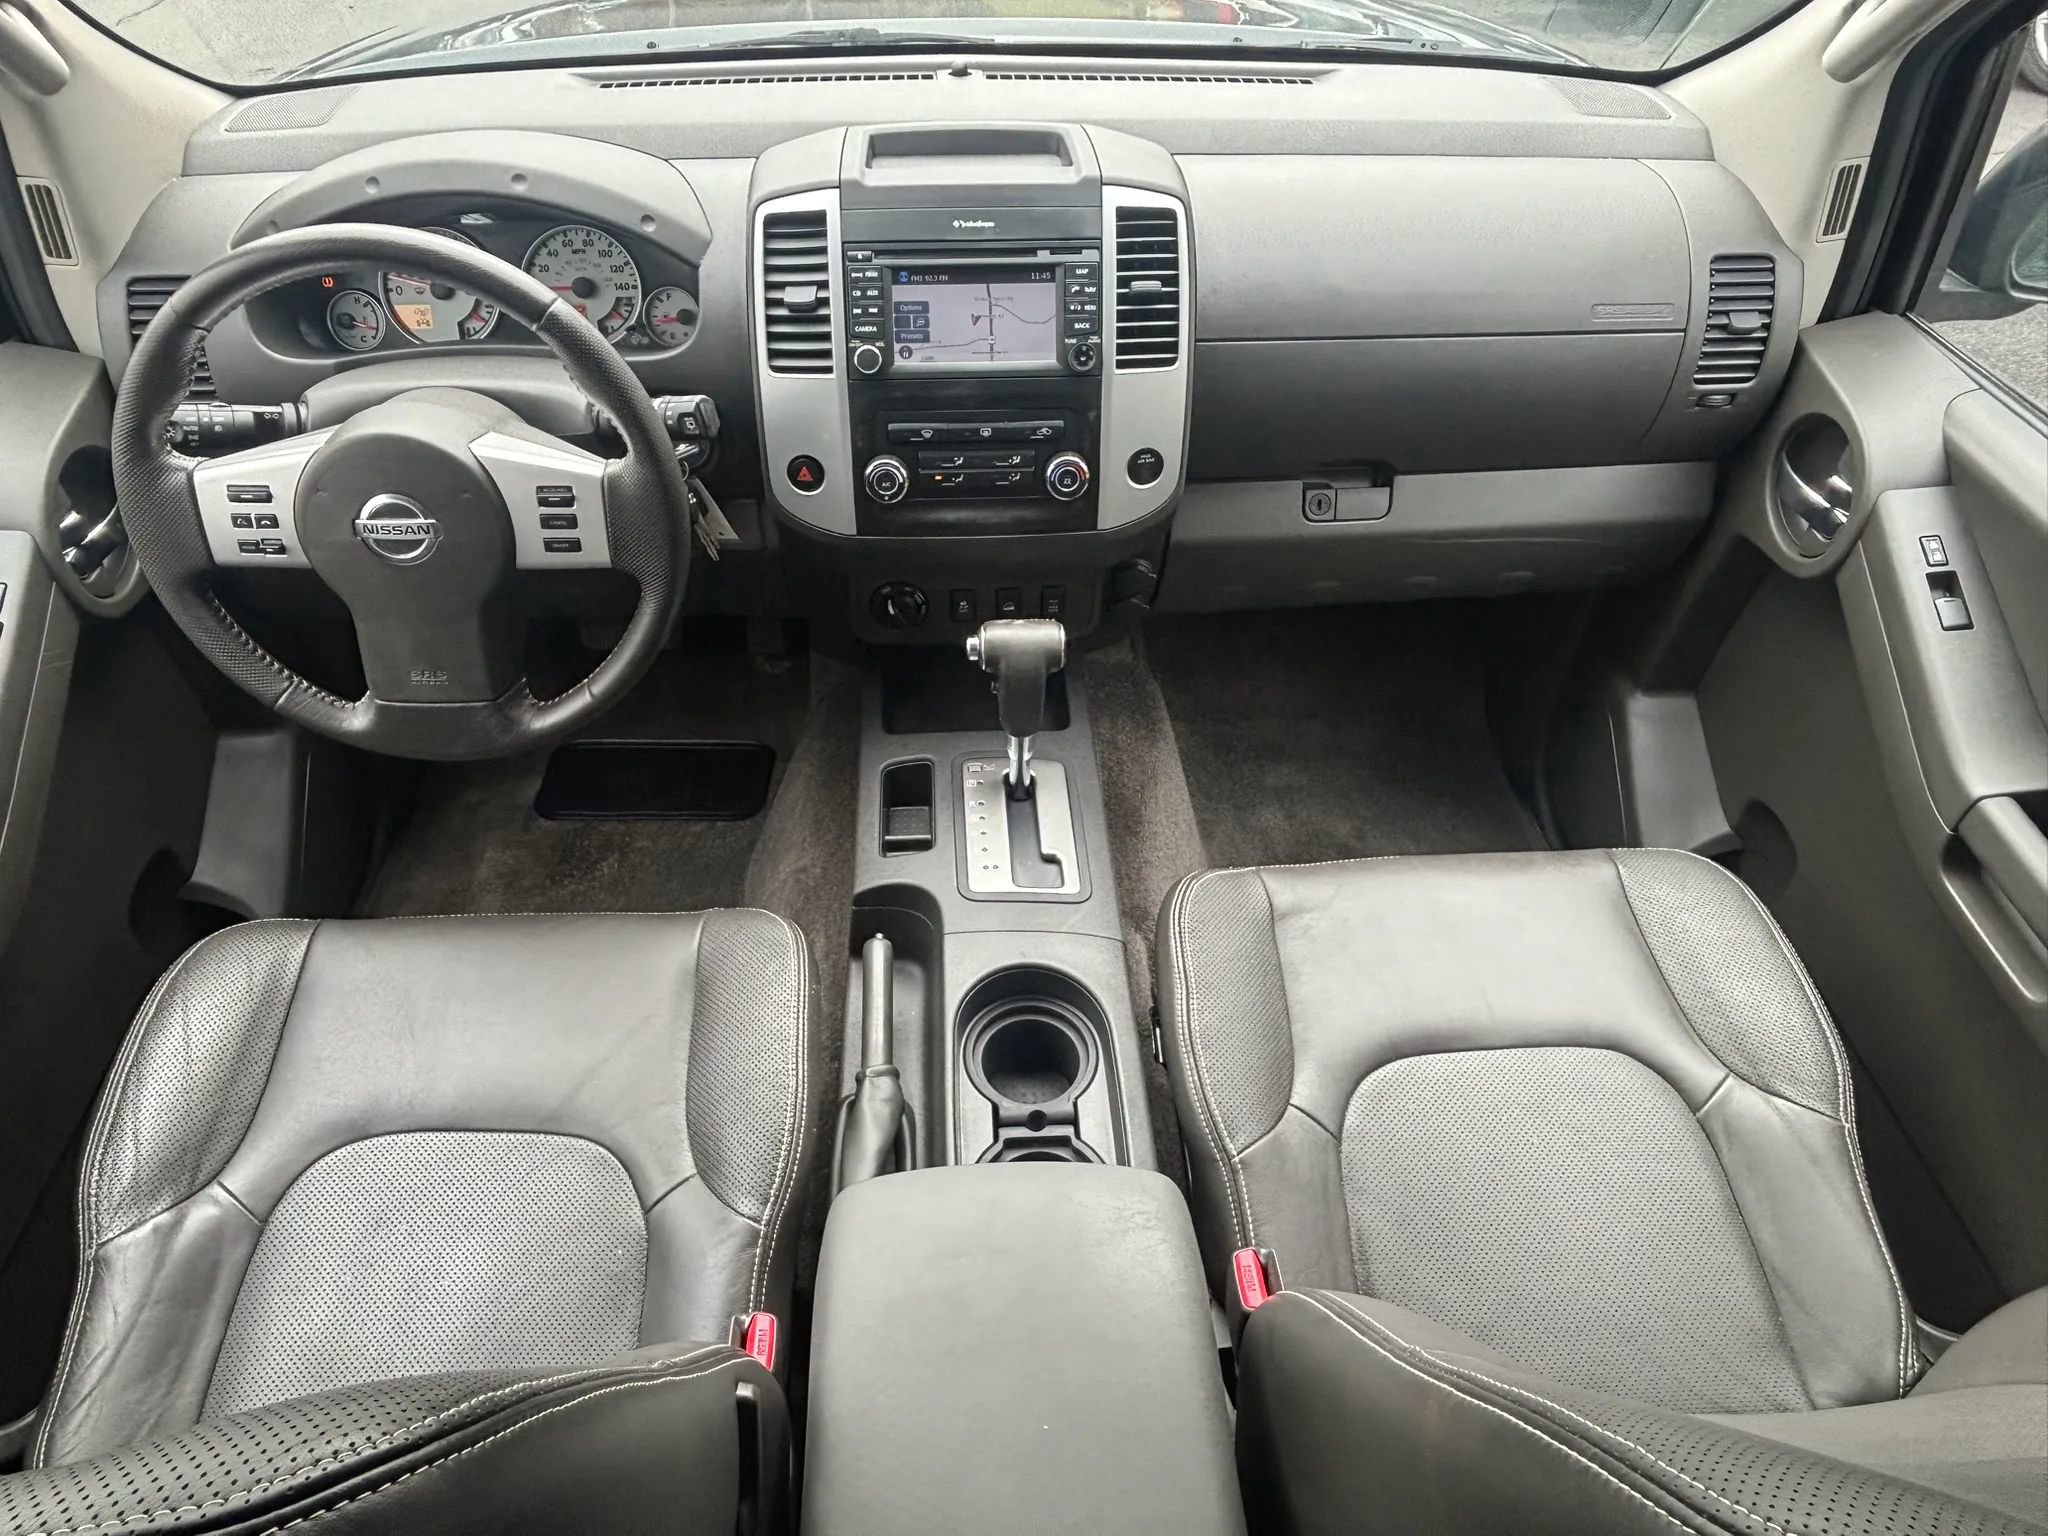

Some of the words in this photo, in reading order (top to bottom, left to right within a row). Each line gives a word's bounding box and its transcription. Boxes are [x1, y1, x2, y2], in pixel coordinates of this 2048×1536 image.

[562, 239, 574, 247] 60
[582, 239, 594, 247] 80
[546, 249, 558, 257] 40
[538, 264, 549, 272] 20
[610, 265, 624, 273] 120
[1031, 272, 1051, 280] 11:45
[614, 282, 630, 290] 140
[395, 285, 403, 296] 0
[354, 296, 361, 304] H
[666, 293, 671, 301] F
[360, 335, 367, 343] C
[362, 524, 431, 535] NISSAN
